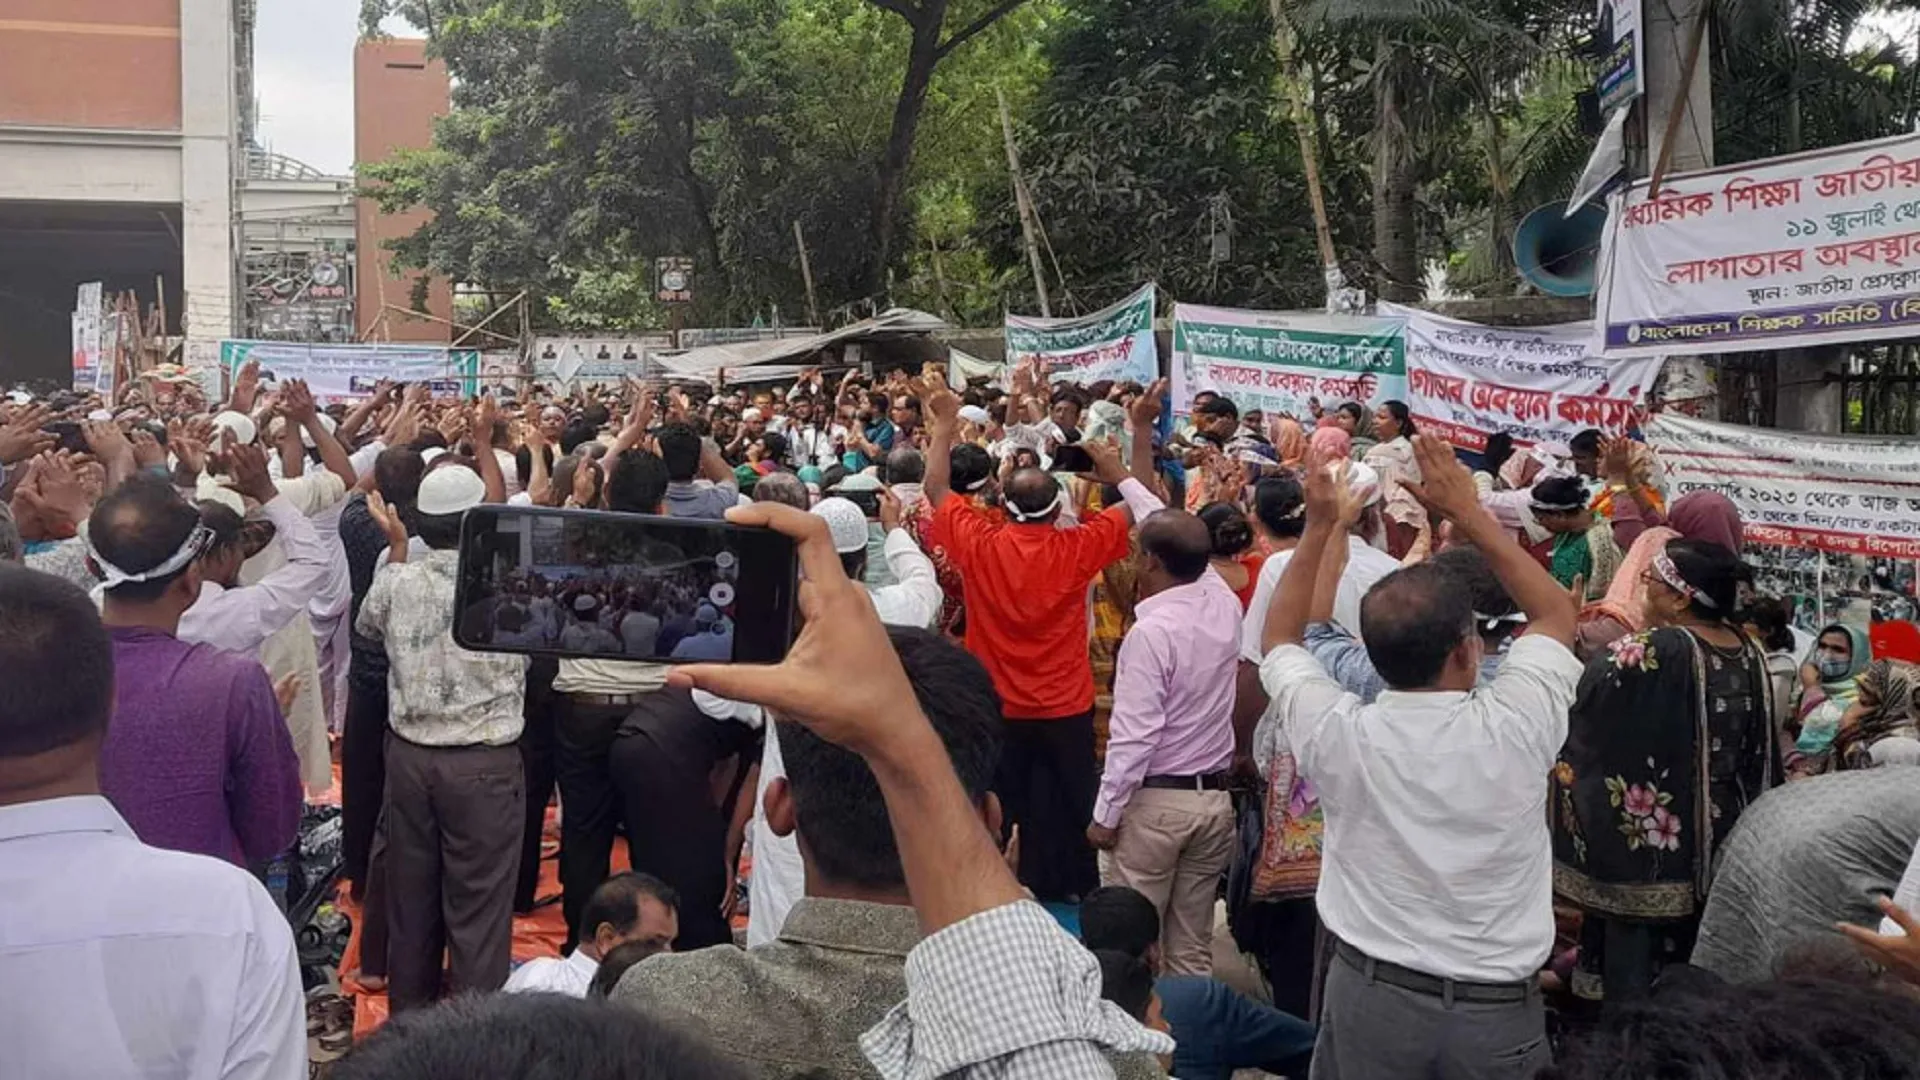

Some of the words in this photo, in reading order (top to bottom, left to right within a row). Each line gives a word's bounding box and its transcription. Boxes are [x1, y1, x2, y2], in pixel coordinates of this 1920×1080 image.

[1723, 177, 1803, 213] শিক্ষা
[1786, 218, 1819, 238] ১১
[1826, 203, 1887, 237] জুলাই
[1666, 249, 1804, 285] লাগাতার
[1795, 274, 1853, 297] জাতীয়
[1640, 321, 1731, 341] বাংলাদেশ
[1738, 311, 1804, 333] শিক্ষক
[1813, 300, 1883, 326] সমিতি
[1208, 364, 1262, 387] লাগাতার
[1266, 370, 1317, 397] অবস্থান
[1320, 371, 1379, 403] কর্মসূচি
[1471, 380, 1552, 422] অবস্থান
[1749, 486, 1798, 505] ২০২৩
[1804, 490, 1853, 510] থেকে
[1859, 493, 1901, 511] আজ
[1763, 510, 1799, 523] থেকে
